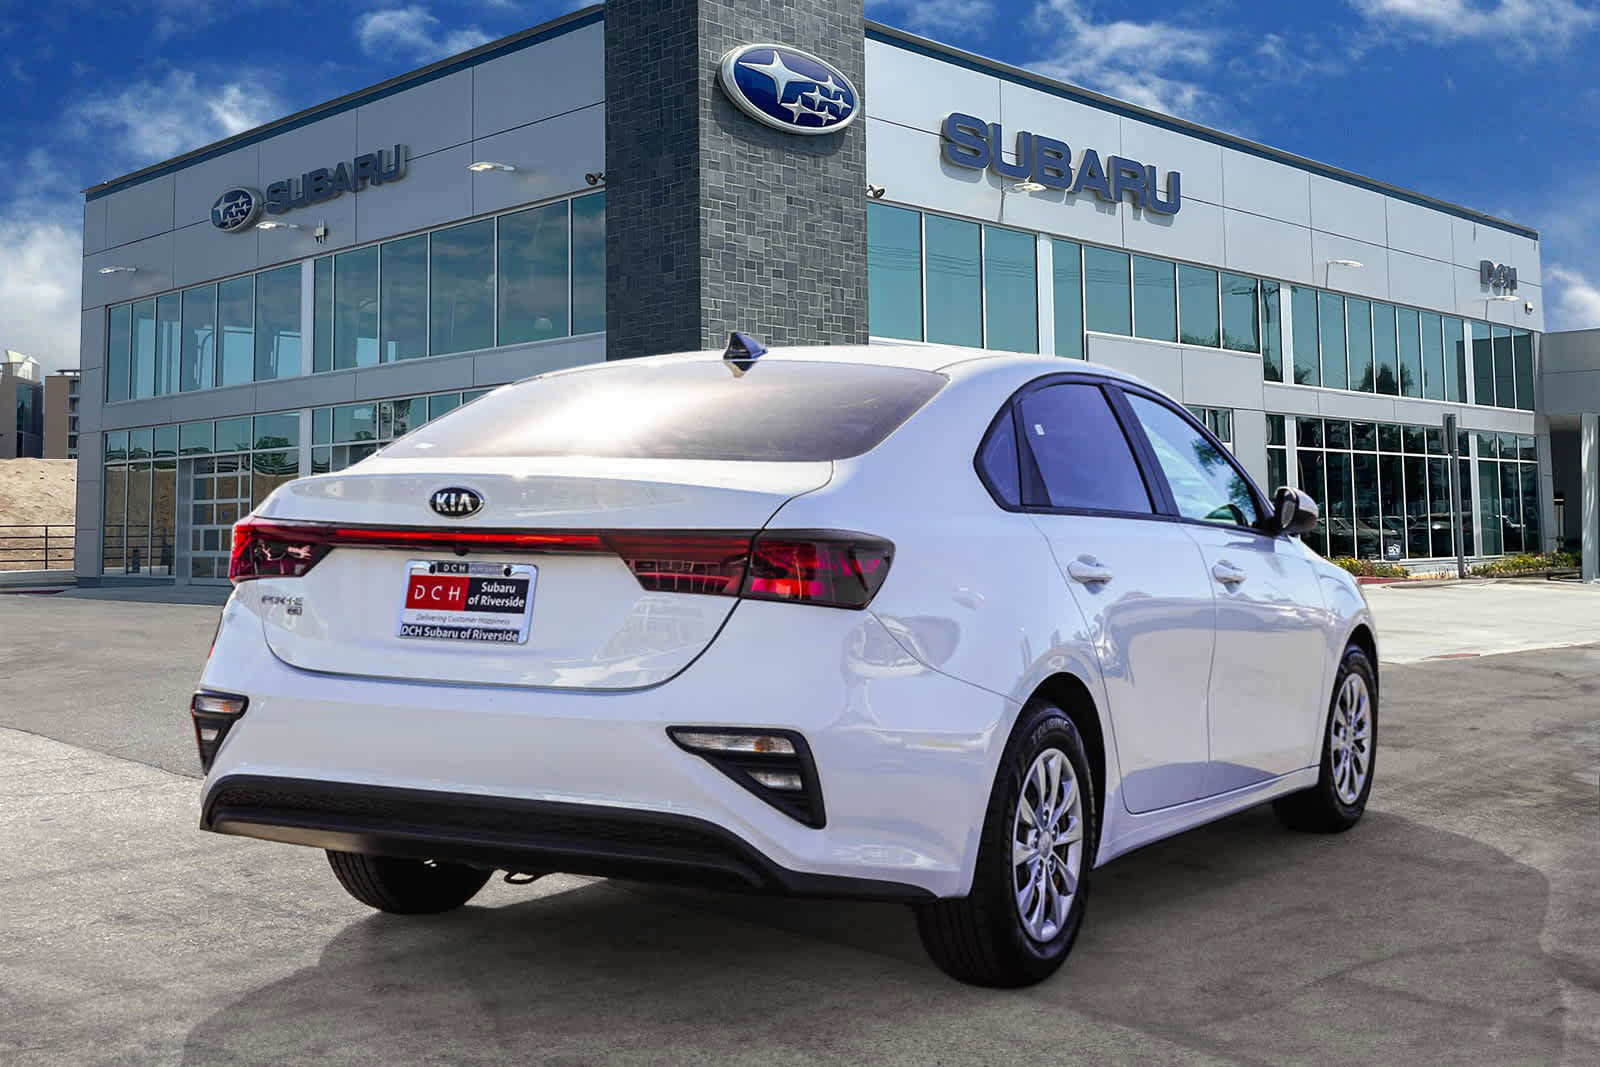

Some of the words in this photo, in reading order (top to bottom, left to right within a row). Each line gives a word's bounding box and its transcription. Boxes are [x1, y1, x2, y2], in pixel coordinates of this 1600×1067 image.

[942, 112, 1181, 215] SUBARU
[266, 144, 406, 214] SUBARU
[436, 493, 473, 511] KIA
[481, 581, 516, 594] Subaru
[468, 594, 480, 606] of
[480, 595, 525, 608] Riverside
[415, 613, 446, 623] Delivering
[448, 615, 478, 624] Customer
[401, 625, 422, 637] DCH
[424, 626, 459, 638] Subaru
[460, 628, 471, 639] of
[472, 629, 519, 641] Riverside
